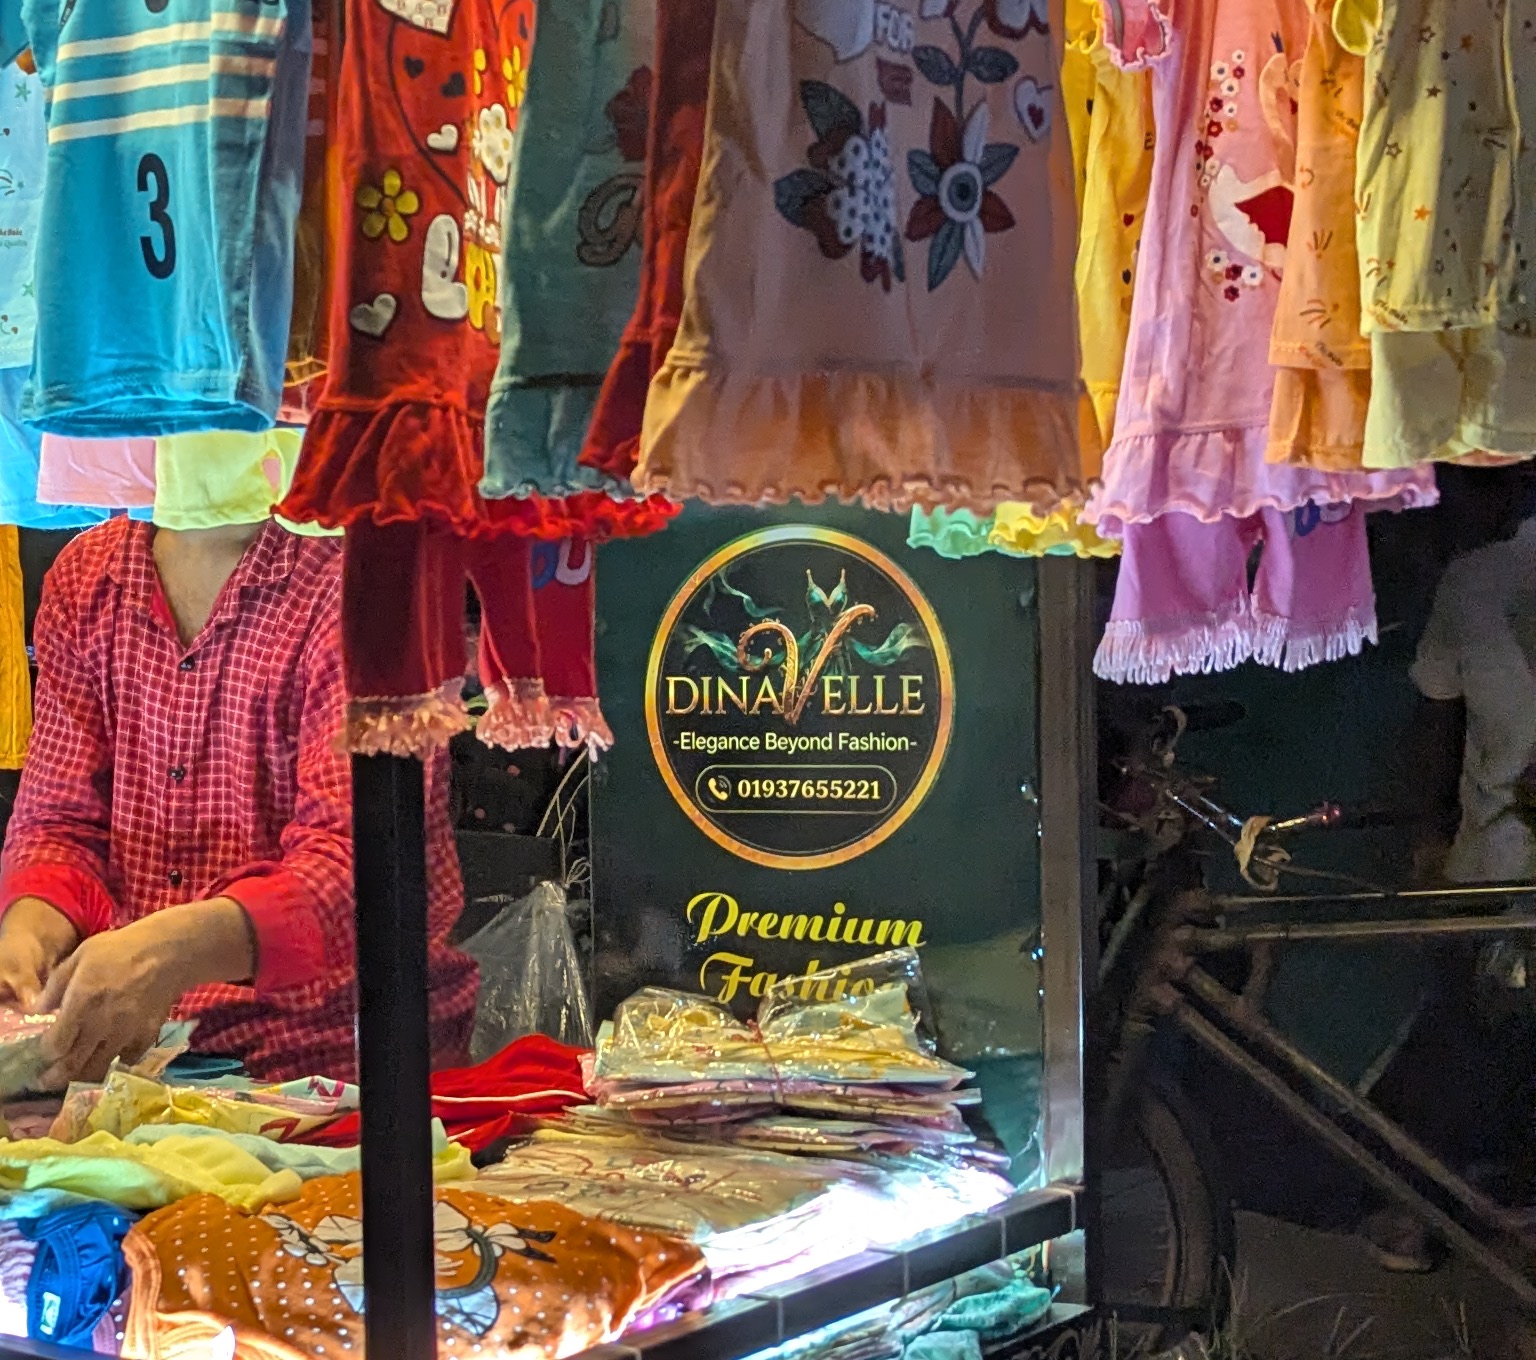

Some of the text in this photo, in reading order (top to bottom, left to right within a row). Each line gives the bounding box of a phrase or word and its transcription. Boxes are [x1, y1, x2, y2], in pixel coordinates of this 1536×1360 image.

[137, 151, 177, 280] 3
[765, 731, 832, 755] Beyond
[737, 778, 881, 800] 01937655221
[687, 892, 927, 947] Premium
[700, 951, 898, 1004] Fashio
